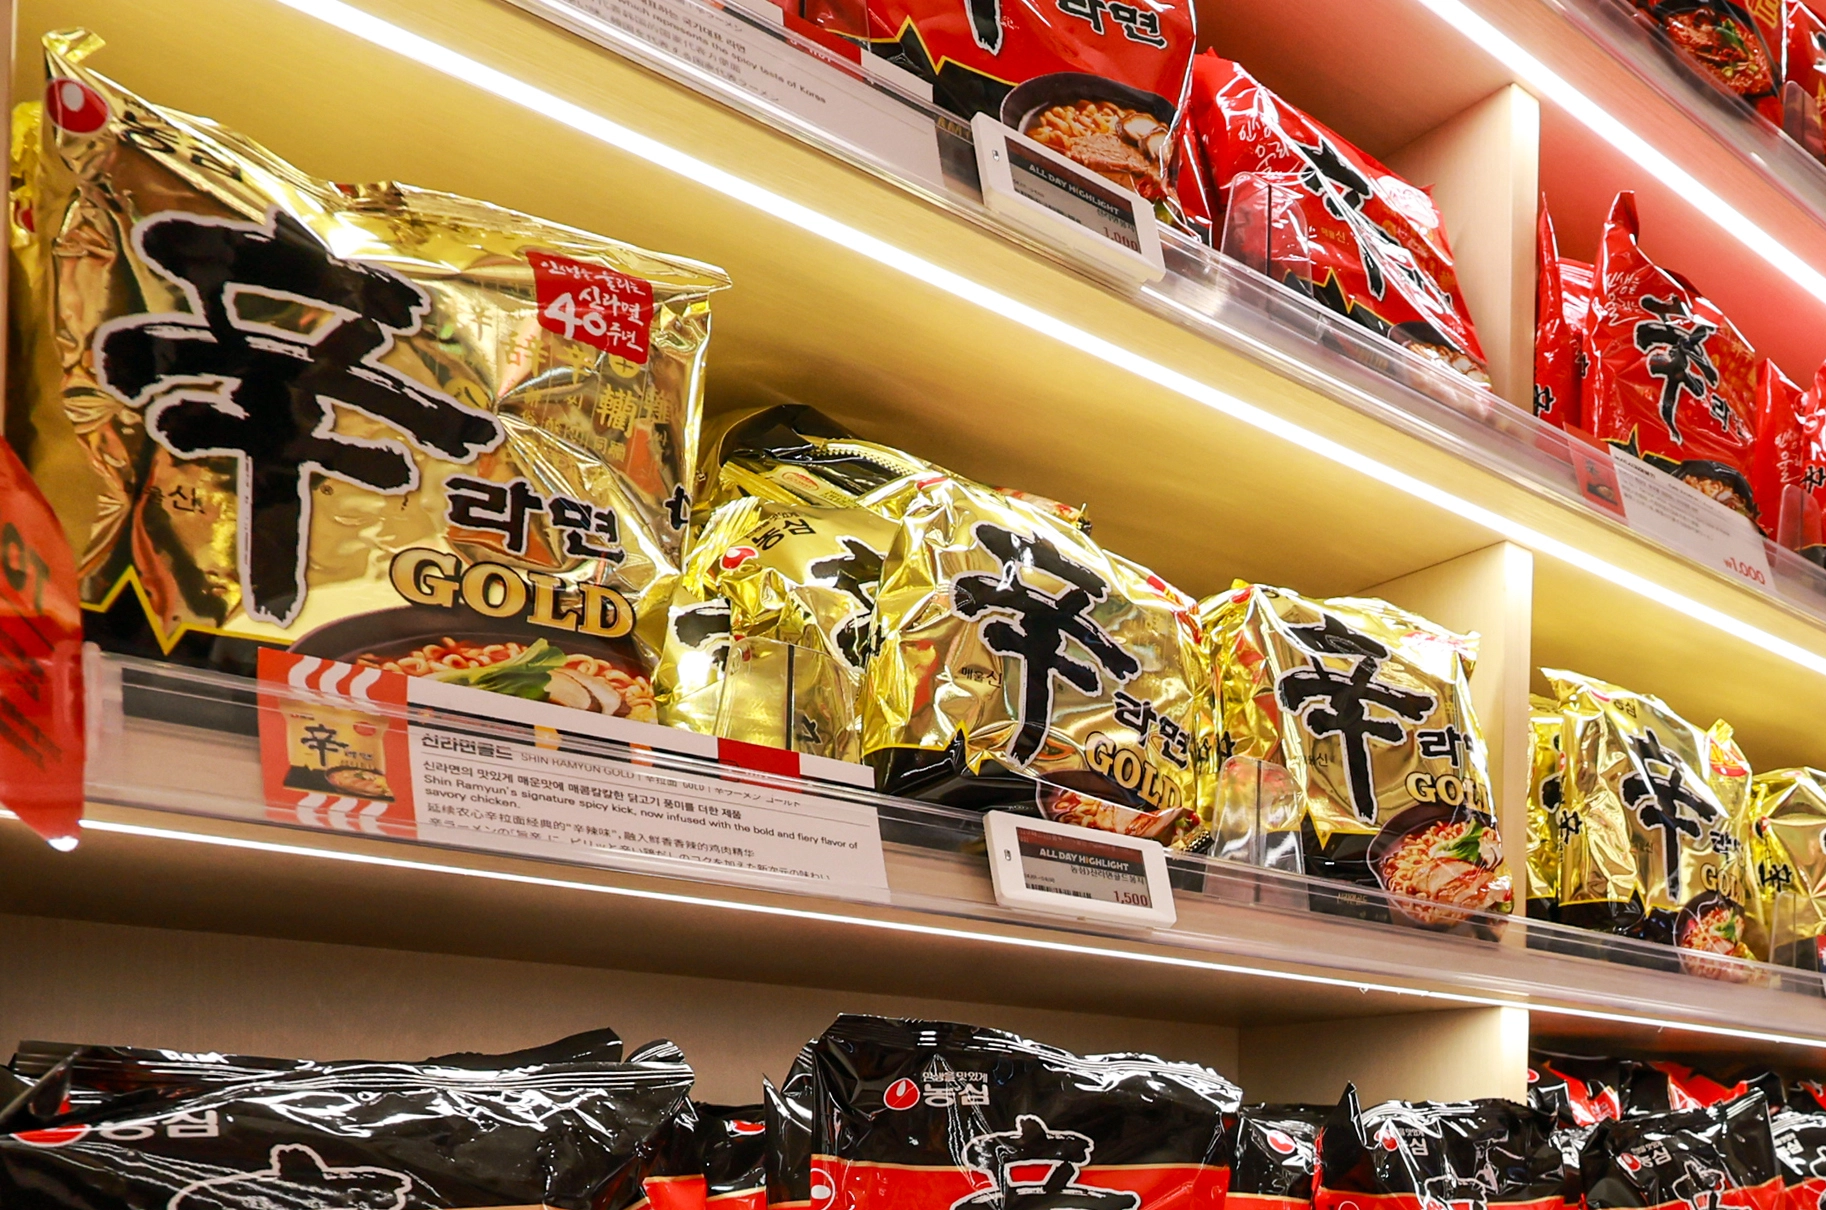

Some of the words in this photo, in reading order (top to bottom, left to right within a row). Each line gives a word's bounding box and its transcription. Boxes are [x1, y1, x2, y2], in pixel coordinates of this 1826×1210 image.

[800, 86, 827, 104] Korea
[1029, 163, 1049, 179] ALL
[1048, 173, 1068, 189] DAY
[1068, 183, 1121, 216] HIGHLIGHT
[543, 291, 608, 340] 40
[606, 321, 644, 353] 주년
[578, 285, 645, 327] 신라면
[94, 204, 503, 626] 辛
[442, 475, 626, 563] 라면
[751, 518, 816, 551] 농심
[387, 546, 638, 639] GOLD
[949, 520, 1142, 769] 辛
[300, 723, 350, 767] 辛
[420, 732, 514, 761] 신라면골드
[1111, 690, 1190, 770] 라면
[1273, 610, 1439, 826] 辛
[422, 759, 474, 778] 신라면의
[477, 768, 514, 784] 맛있게
[517, 774, 565, 792] 매운맛에
[567, 782, 625, 802] 매콤칼칼한
[627, 791, 661, 808] 닭고기
[663, 796, 695, 813] 풍미를
[697, 802, 719, 817] 더한
[721, 807, 742, 821] 제품
[520, 751, 550, 766] SHIN
[551, 757, 602, 774] RAMYUN
[603, 765, 635, 780] GOLD
[1083, 731, 1183, 813] GOLD
[423, 774, 453, 787] Shin
[456, 778, 519, 798] Ramyun's
[520, 788, 576, 806] signature
[579, 797, 608, 812] spicy
[611, 802, 638, 817] kick,
[639, 809, 665, 820] now
[666, 811, 707, 826] infused
[708, 817, 732, 831] with
[733, 821, 752, 834] the
[752, 824, 776, 838] bold
[777, 828, 796, 841] and
[797, 831, 819, 845] fiery
[820, 835, 847, 849] flavor
[848, 840, 859, 851] of
[424, 786, 467, 802] savory
[469, 792, 521, 810] chicken.
[1618, 726, 1721, 904] 辛
[1039, 847, 1058, 860] ALL
[1058, 851, 1078, 863] DAY
[1078, 855, 1129, 872] HIGHLIGHT
[1113, 889, 1149, 907] 1,500
[921, 1081, 992, 1107] 농심
